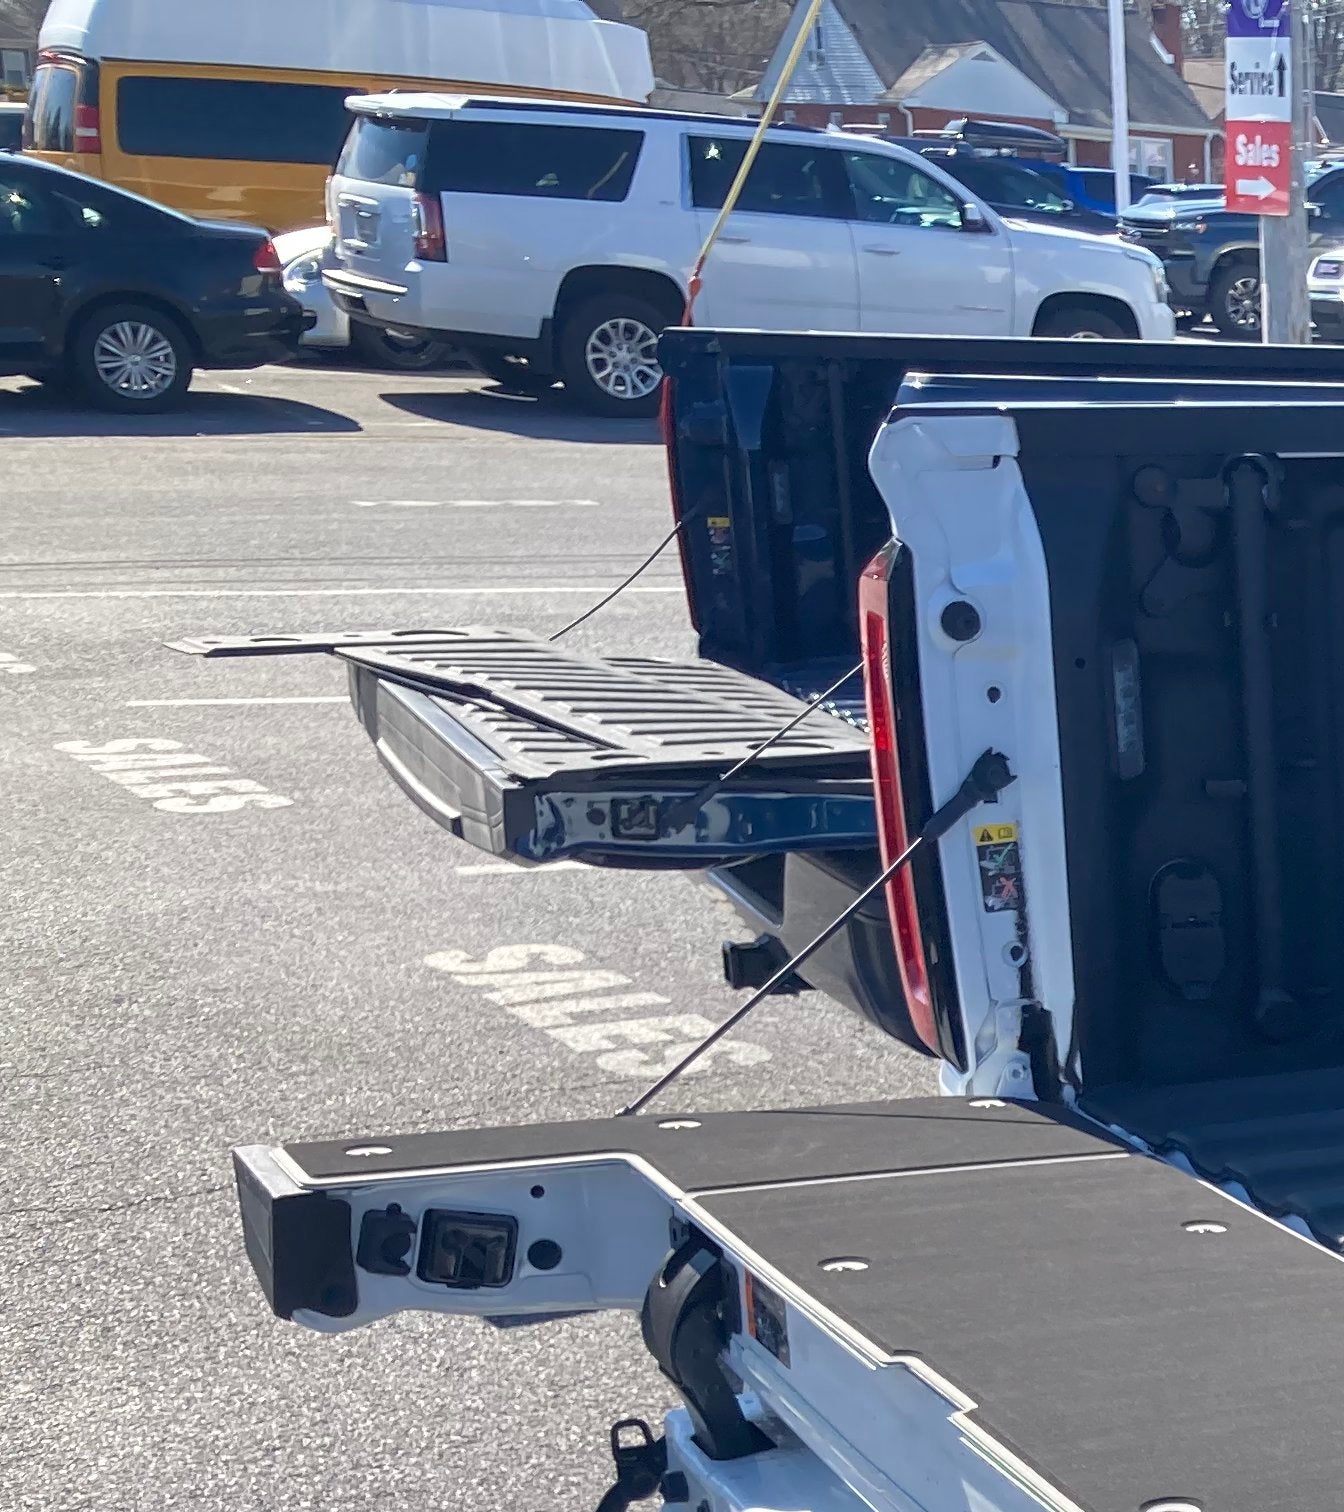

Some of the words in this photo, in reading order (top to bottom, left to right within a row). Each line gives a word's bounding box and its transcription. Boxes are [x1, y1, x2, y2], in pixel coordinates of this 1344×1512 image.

[1231, 61, 1275, 96] Service
[1235, 134, 1280, 168] Sales
[52, 737, 295, 814] SALES
[422, 943, 773, 1078] SALES
